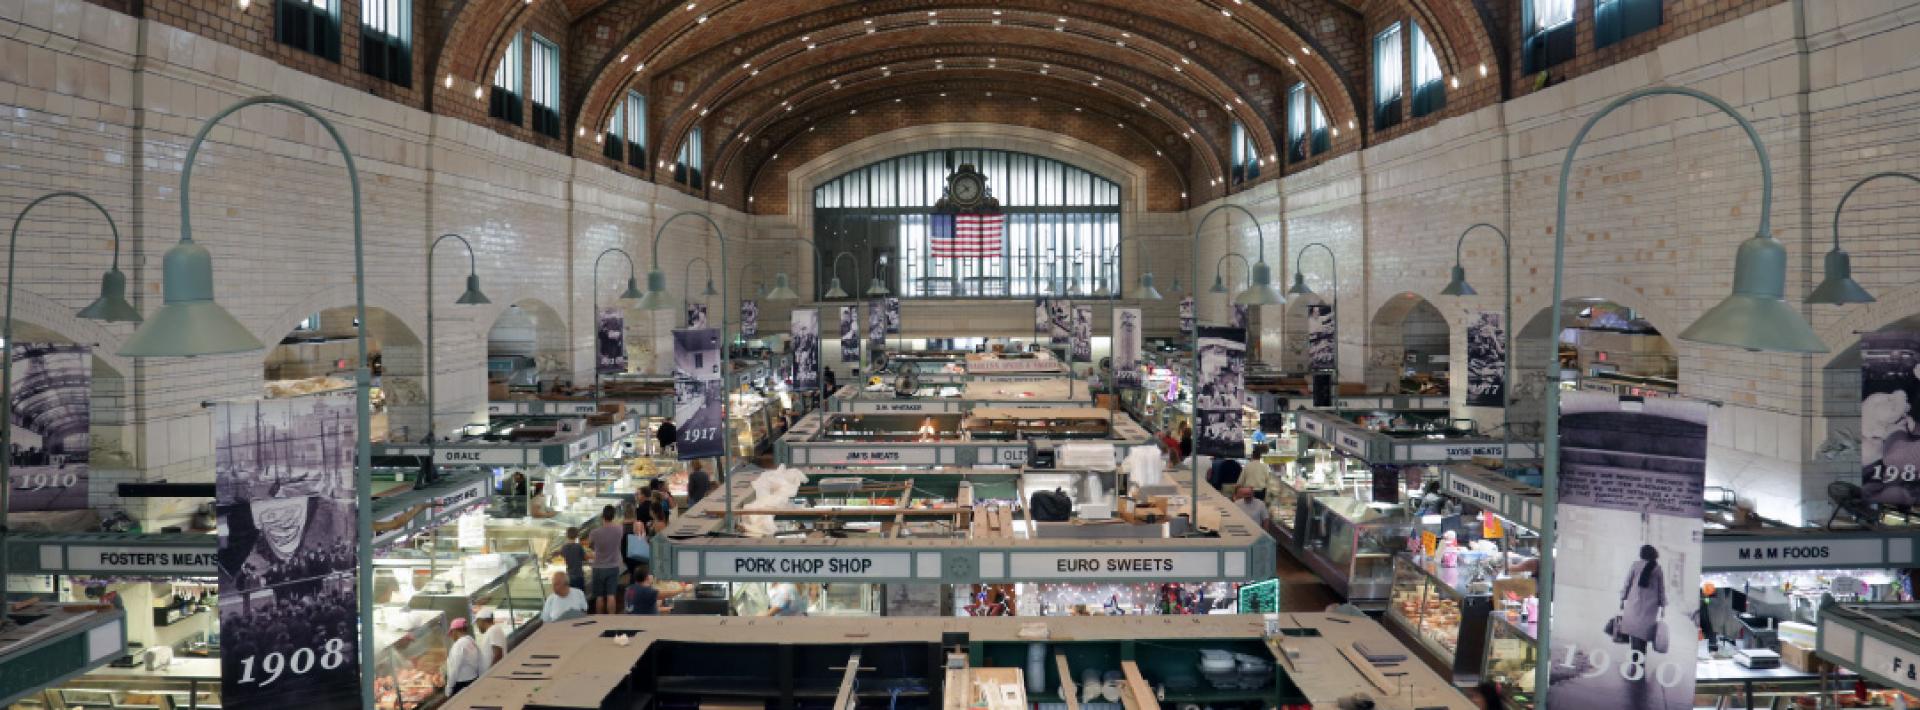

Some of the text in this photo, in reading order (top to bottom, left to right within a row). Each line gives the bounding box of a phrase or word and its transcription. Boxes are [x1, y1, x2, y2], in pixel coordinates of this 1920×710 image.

[685, 427, 717, 442] 1917
[446, 452, 480, 461] ORALE
[847, 452, 869, 460] JIM'S
[1473, 446, 1502, 455] MEATS
[1871, 464, 1920, 483] 198
[21, 473, 77, 492] 1910
[100, 552, 219, 565] FOSTER'S MEATS
[1739, 546, 1829, 560] M & M FOODS
[735, 558, 872, 573] PORK CHOP SHOP
[1057, 558, 1174, 572] EURO SWEETS
[238, 639, 344, 687] 1908
[1559, 643, 1682, 688] 1980
[1893, 657, 1917, 680] F &
